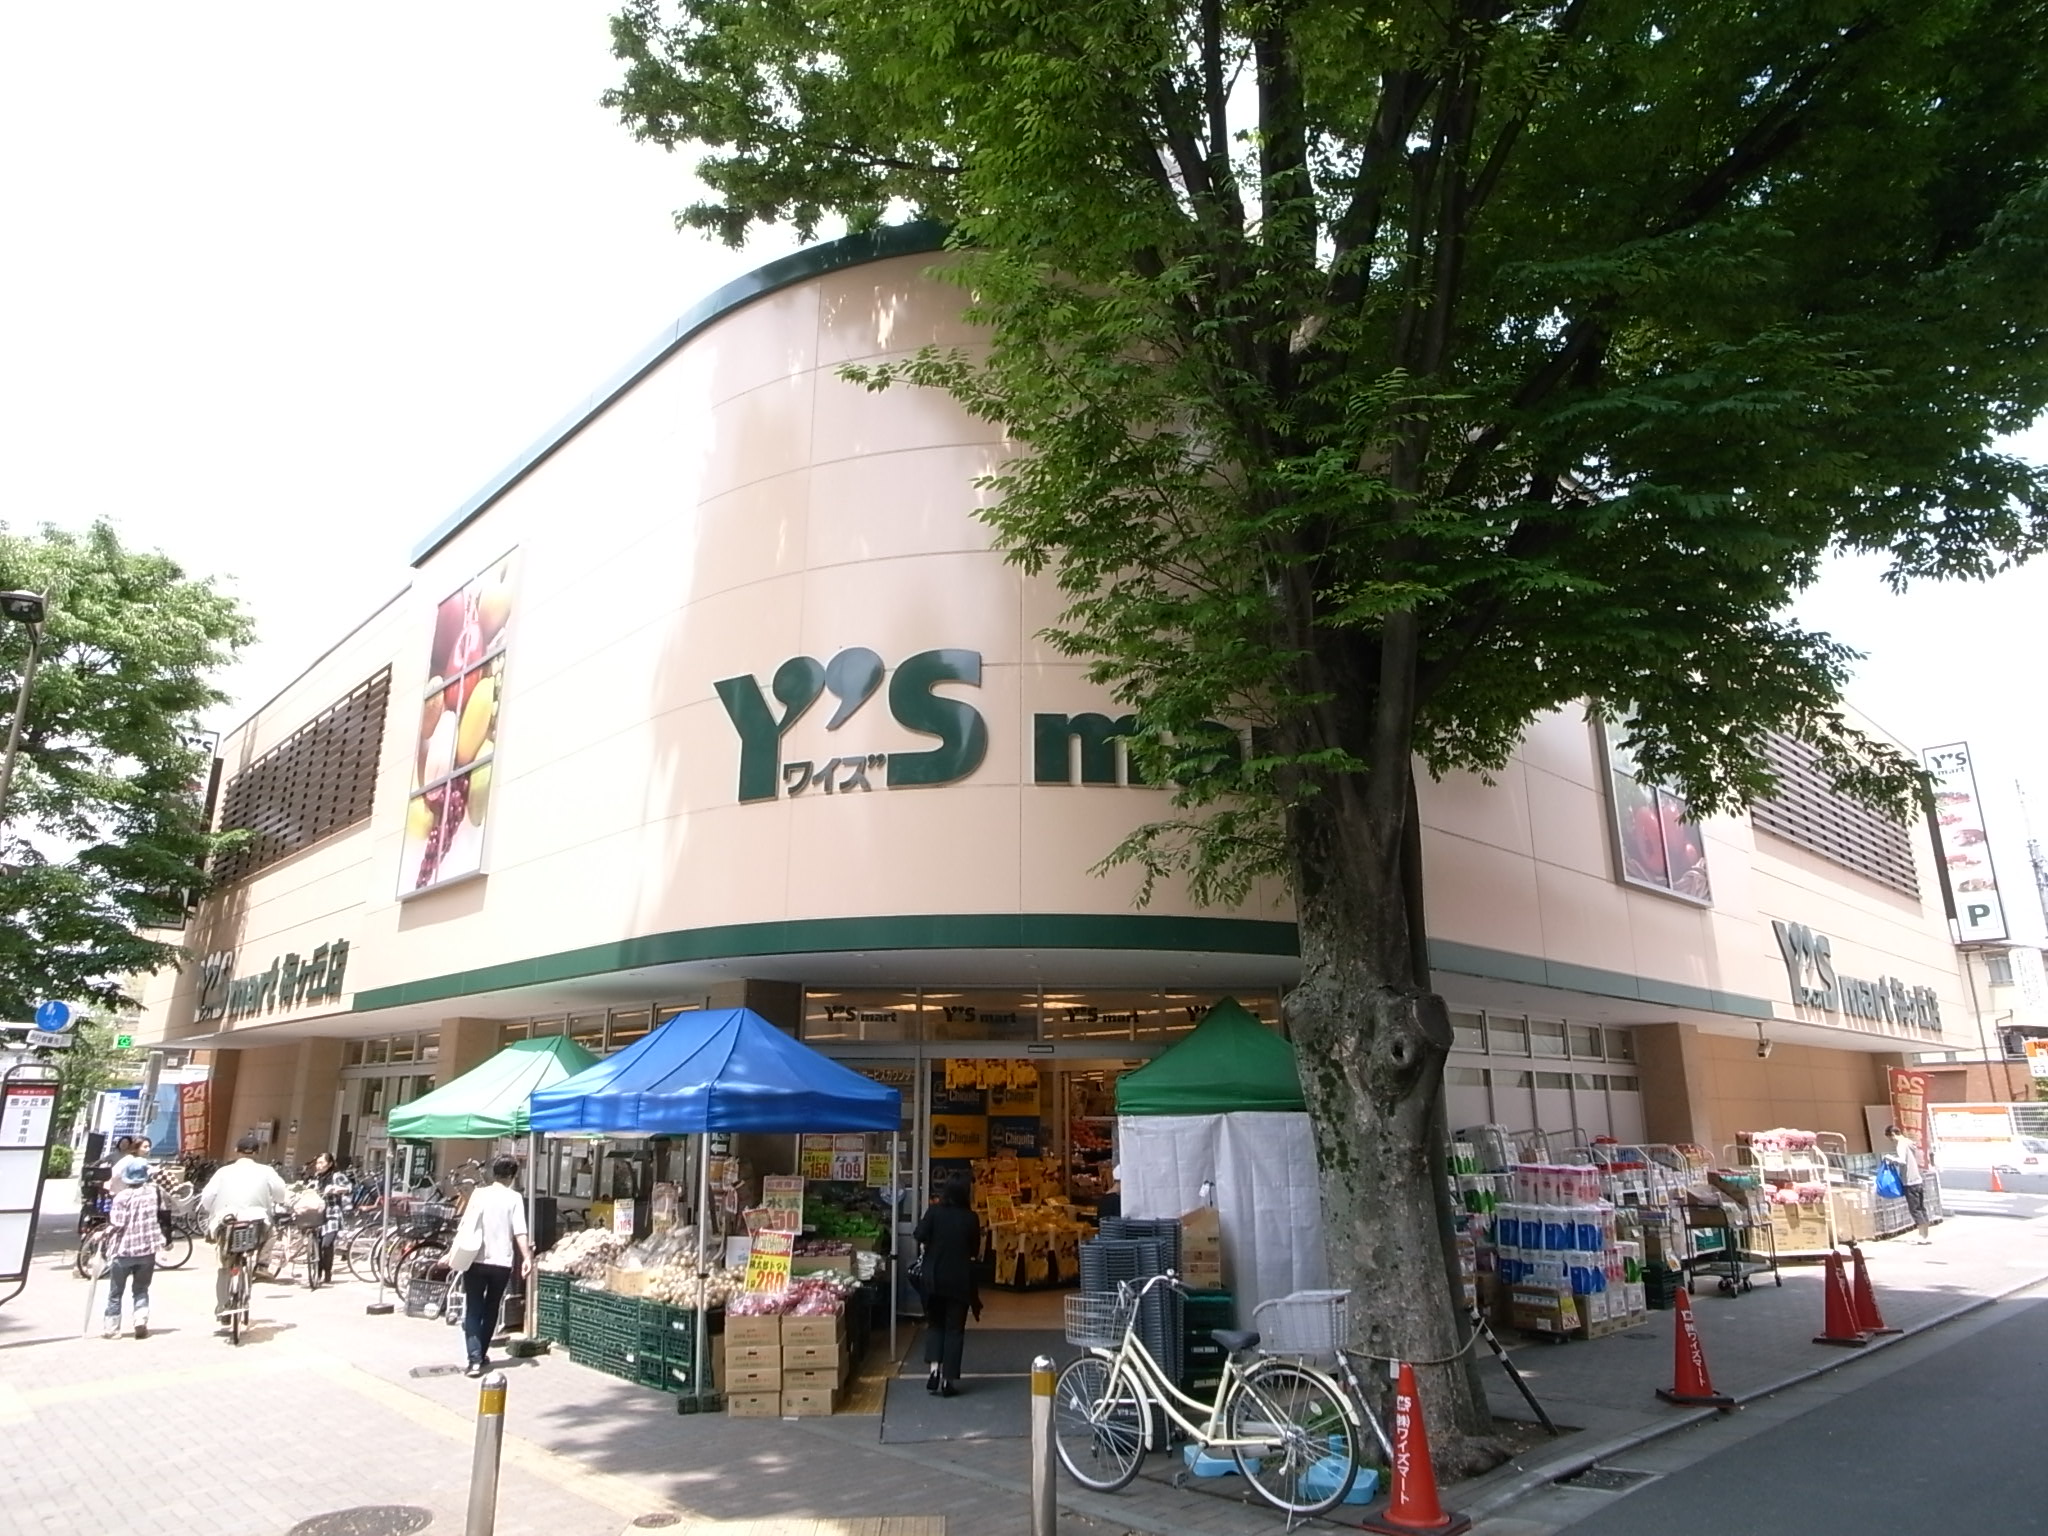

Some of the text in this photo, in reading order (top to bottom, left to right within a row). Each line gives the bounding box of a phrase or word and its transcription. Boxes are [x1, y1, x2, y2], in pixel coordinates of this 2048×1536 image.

[783, 754, 886, 795] ワイズ
[1967, 904, 1991, 927] P
[229, 956, 280, 1017] mart
[1837, 976, 1895, 1024] mart
[860, 1011, 898, 1023] mart
[980, 1012, 1017, 1023] mart
[1102, 1011, 1140, 1024] mart
[1006, 1131, 1034, 1149] Chiquita
[810, 1162, 830, 1179] 159
[840, 1162, 861, 1179] 199
